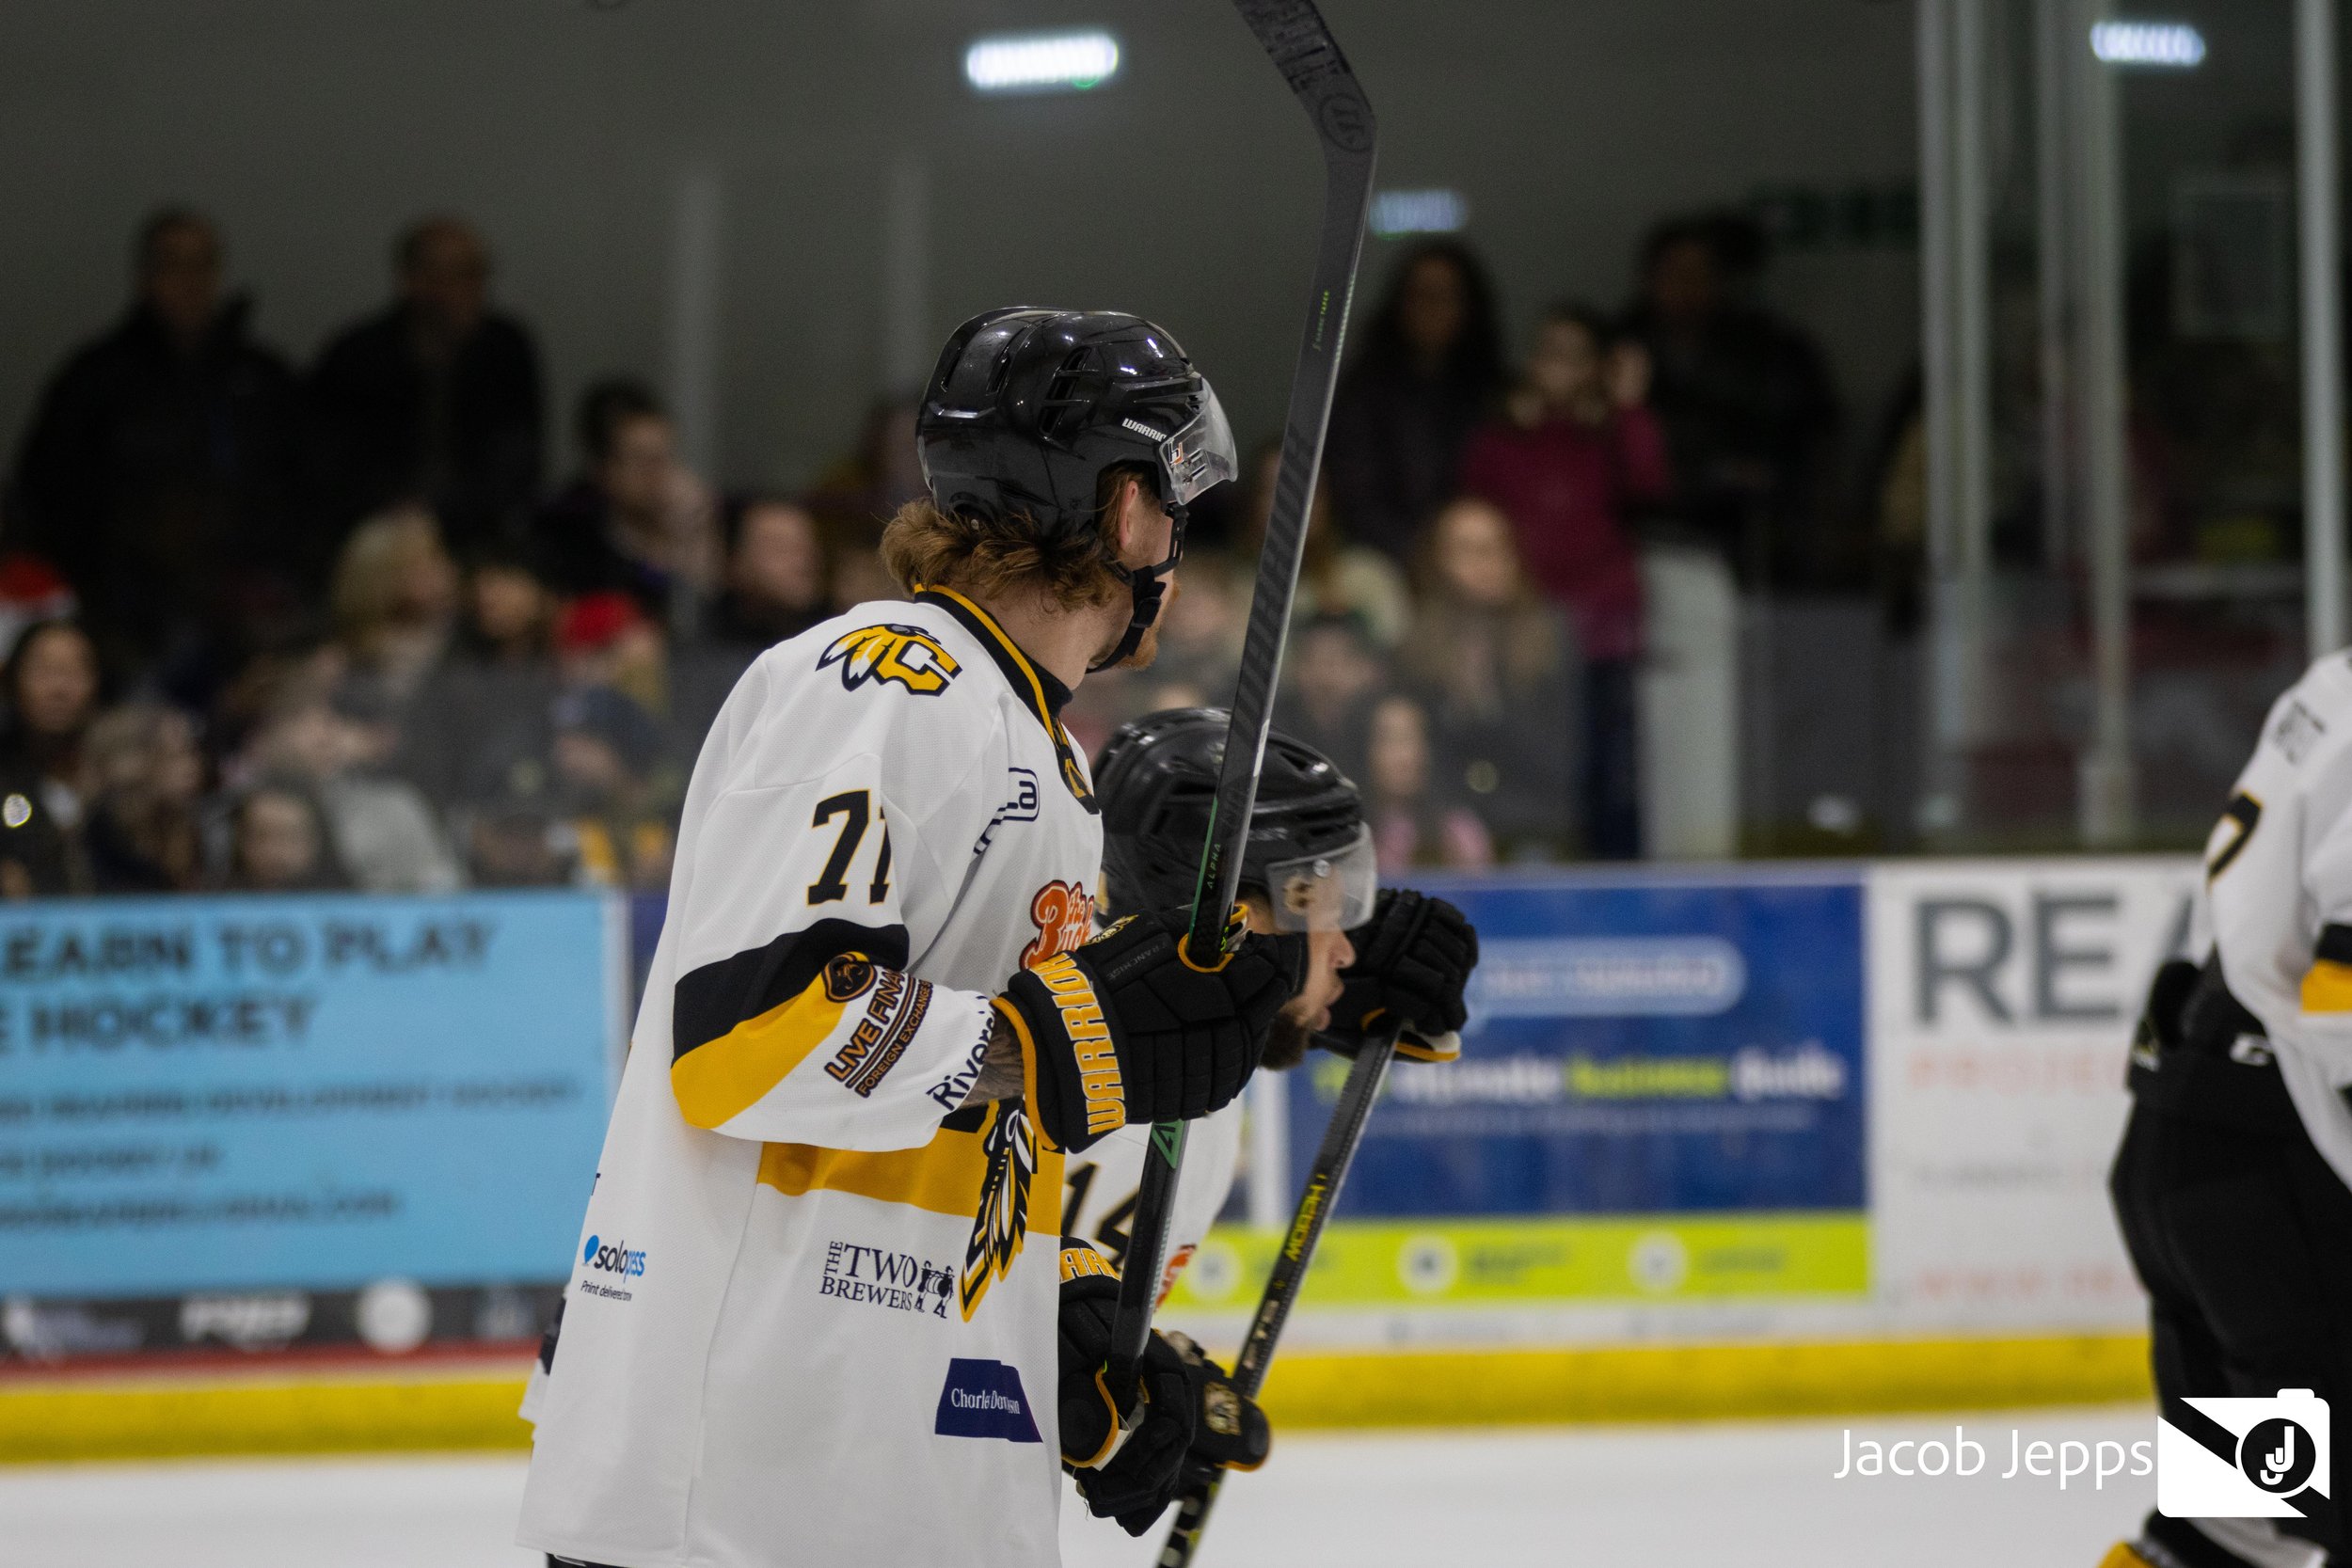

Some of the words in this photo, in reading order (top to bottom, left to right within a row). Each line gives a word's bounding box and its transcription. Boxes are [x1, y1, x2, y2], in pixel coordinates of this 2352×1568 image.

[1121, 418, 1167, 442] WARRIO
[0, 927, 191, 984] EARN
[219, 927, 299, 980] TO
[323, 917, 496, 974] PLAY
[31, 990, 313, 1050] HOCKEY
[824, 1018, 882, 1082] LIVE
[866, 968, 907, 1026] FINA
[1030, 952, 1126, 1135] WARRIOR
[853, 1041, 904, 1099] FOREIGN
[580, 1279, 599, 1295] Print
[818, 1275, 913, 1311] BREWERS
[824, 1241, 844, 1275] THE
[843, 1243, 918, 1288] TWO
